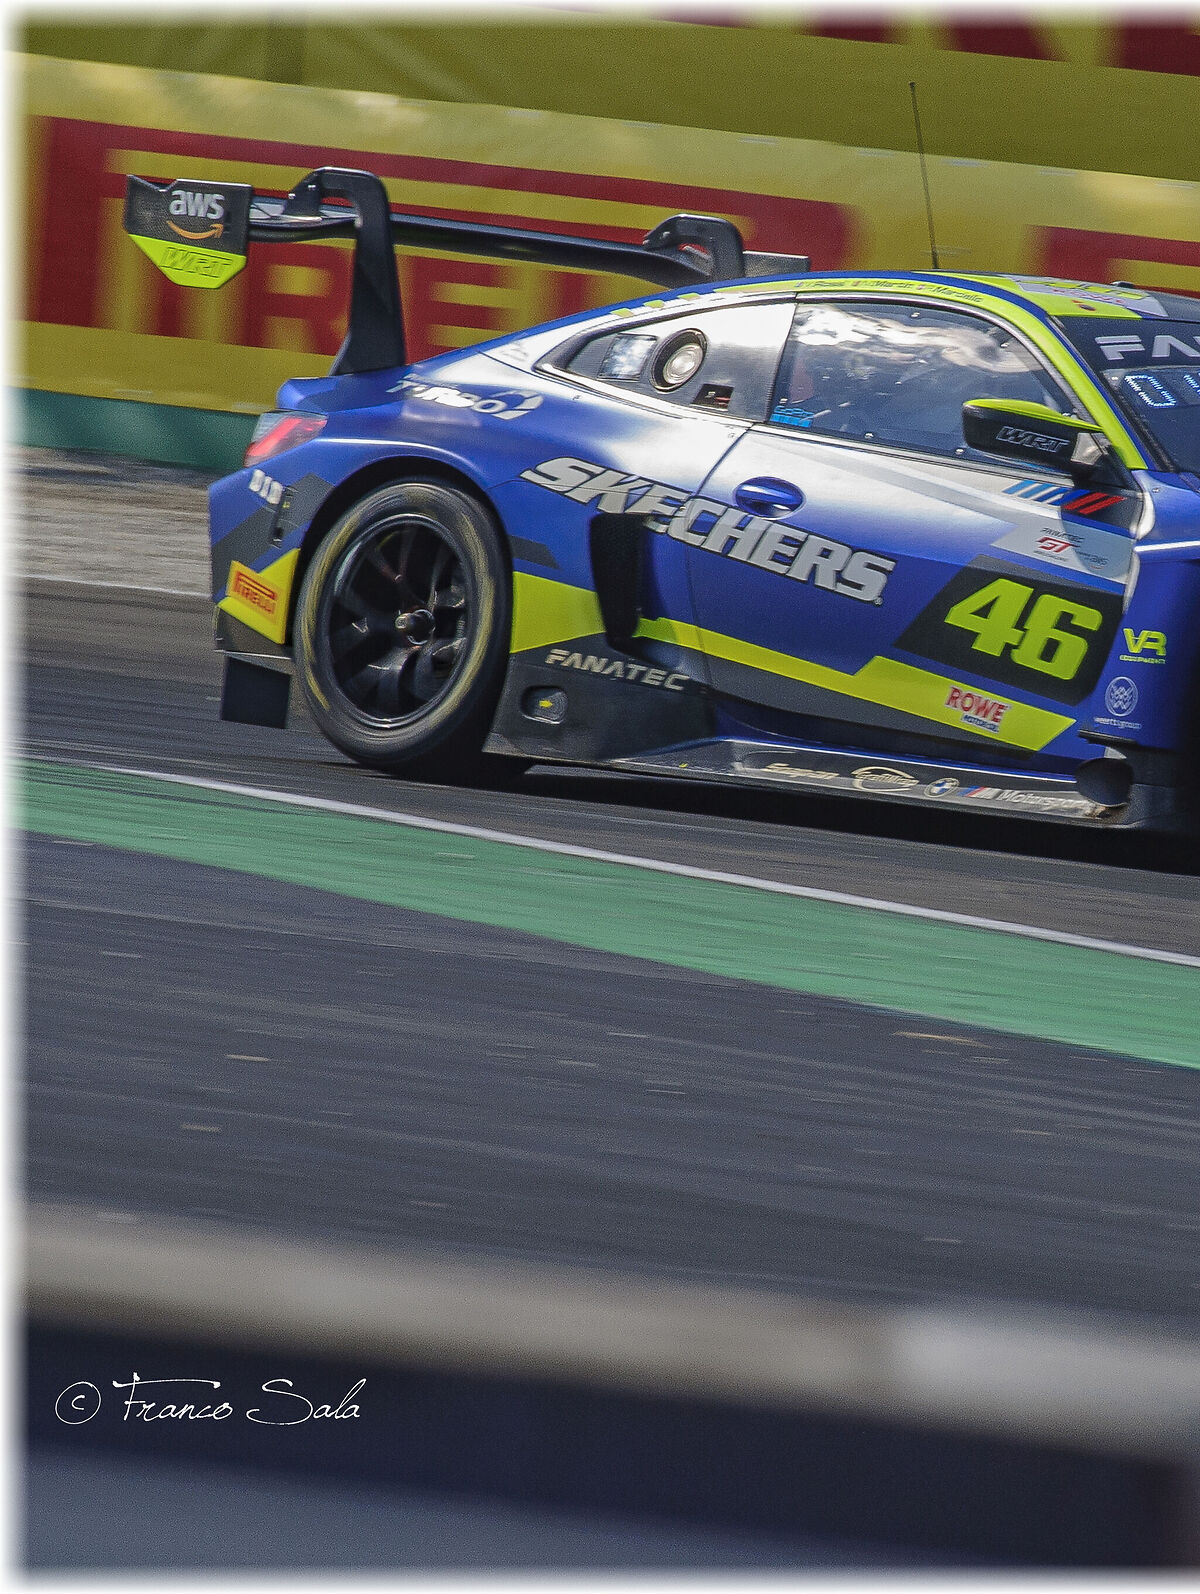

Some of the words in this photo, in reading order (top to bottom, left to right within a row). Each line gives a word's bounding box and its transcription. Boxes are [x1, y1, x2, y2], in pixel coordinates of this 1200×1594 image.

[169, 190, 225, 220] aws
[996, 425, 1070, 452] WRT
[519, 456, 898, 605] SKECHERS
[944, 578, 1103, 680] 46
[1123, 628, 1167, 656] VR
[545, 649, 690, 691] FANATEC
[945, 686, 1007, 723] ROWE
